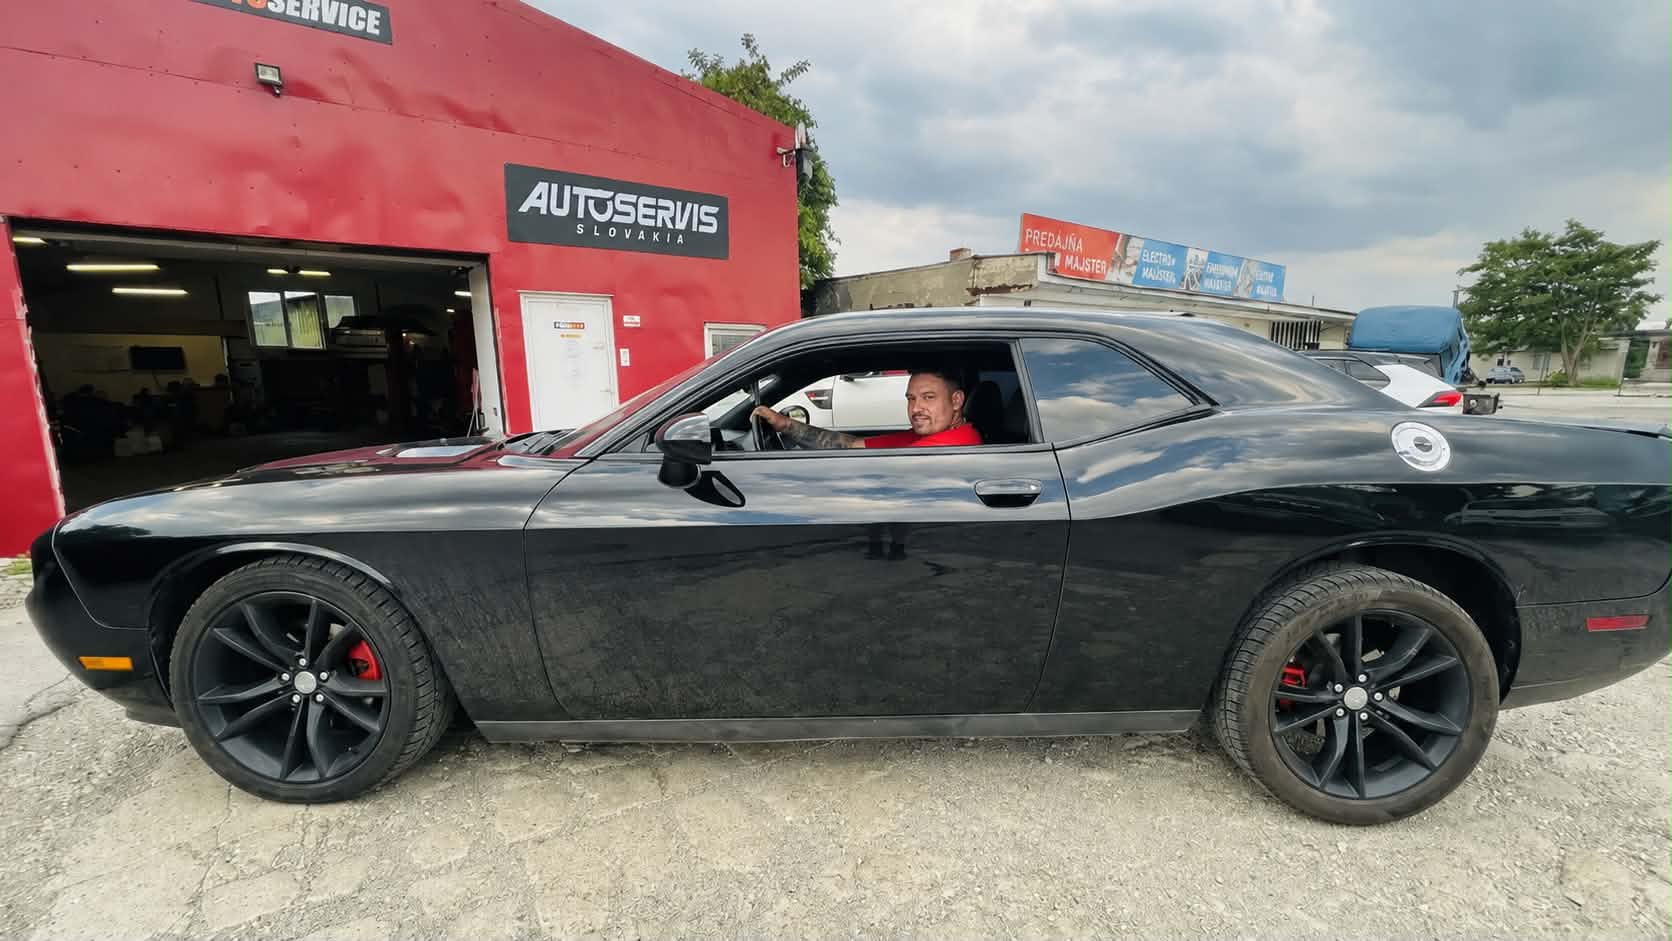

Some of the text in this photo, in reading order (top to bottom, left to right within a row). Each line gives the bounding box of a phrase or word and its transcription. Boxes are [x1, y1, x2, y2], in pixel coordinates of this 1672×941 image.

[232, 0, 381, 35] SERVICE
[518, 181, 720, 234] AUTOSERVIS
[576, 223, 684, 244] SLOVAKIA
[1064, 255, 1107, 275] MAJSTER
